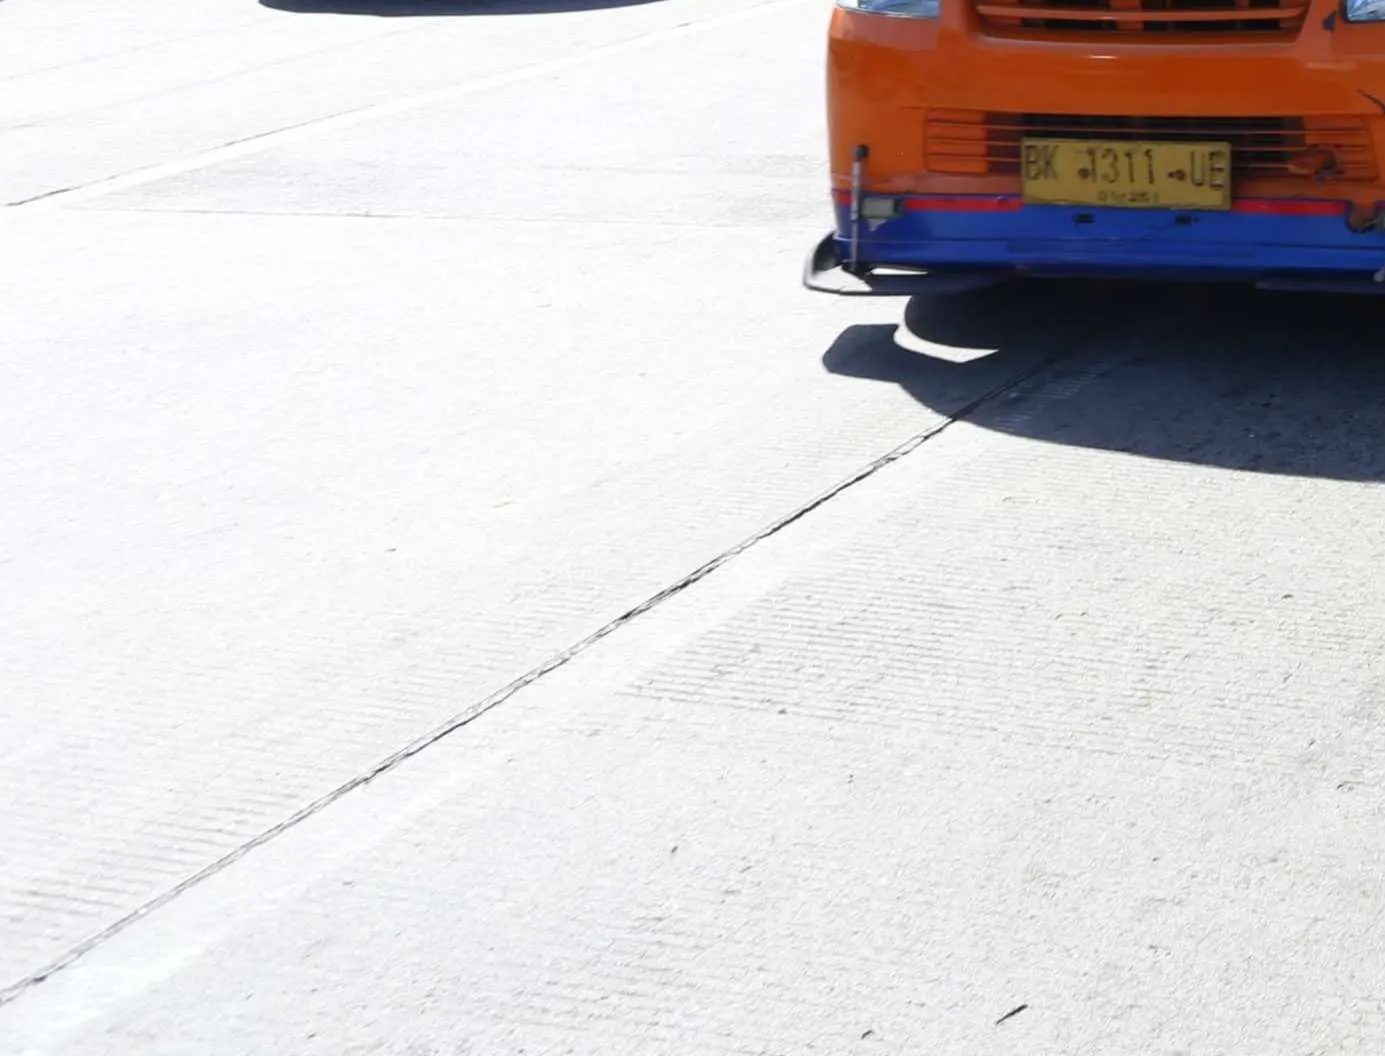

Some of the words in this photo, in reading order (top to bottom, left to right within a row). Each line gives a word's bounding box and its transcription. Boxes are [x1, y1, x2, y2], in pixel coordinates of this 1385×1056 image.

[1024, 144, 1060, 181] BK
[1088, 147, 1155, 185] 1311
[1190, 150, 1225, 191] UE
